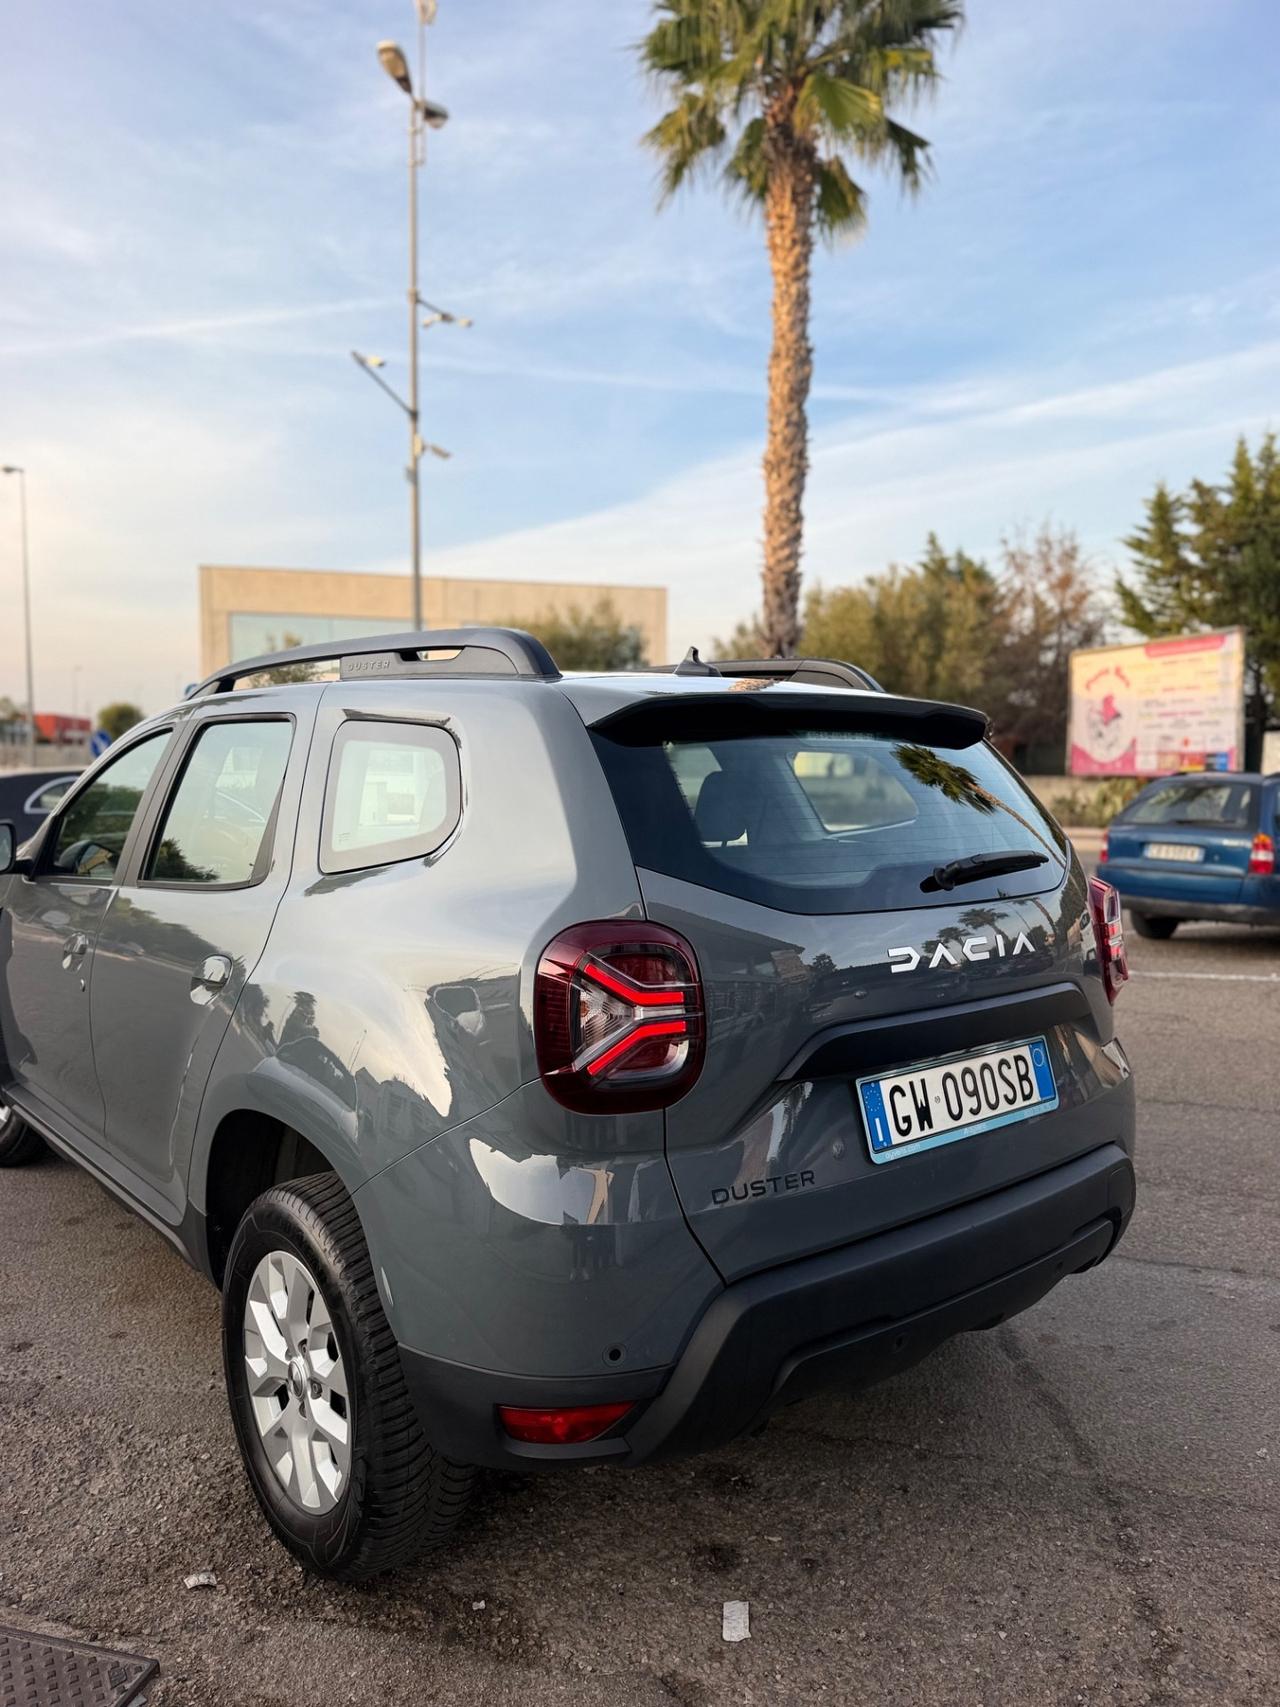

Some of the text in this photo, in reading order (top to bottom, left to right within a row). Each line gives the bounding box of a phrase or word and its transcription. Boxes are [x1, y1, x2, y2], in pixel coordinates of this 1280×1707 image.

[347, 661, 391, 672] DUSTER
[887, 931, 1036, 974] DACIA
[889, 1054, 1034, 1138] GW 090SB
[711, 1169, 816, 1205] DUSTER
